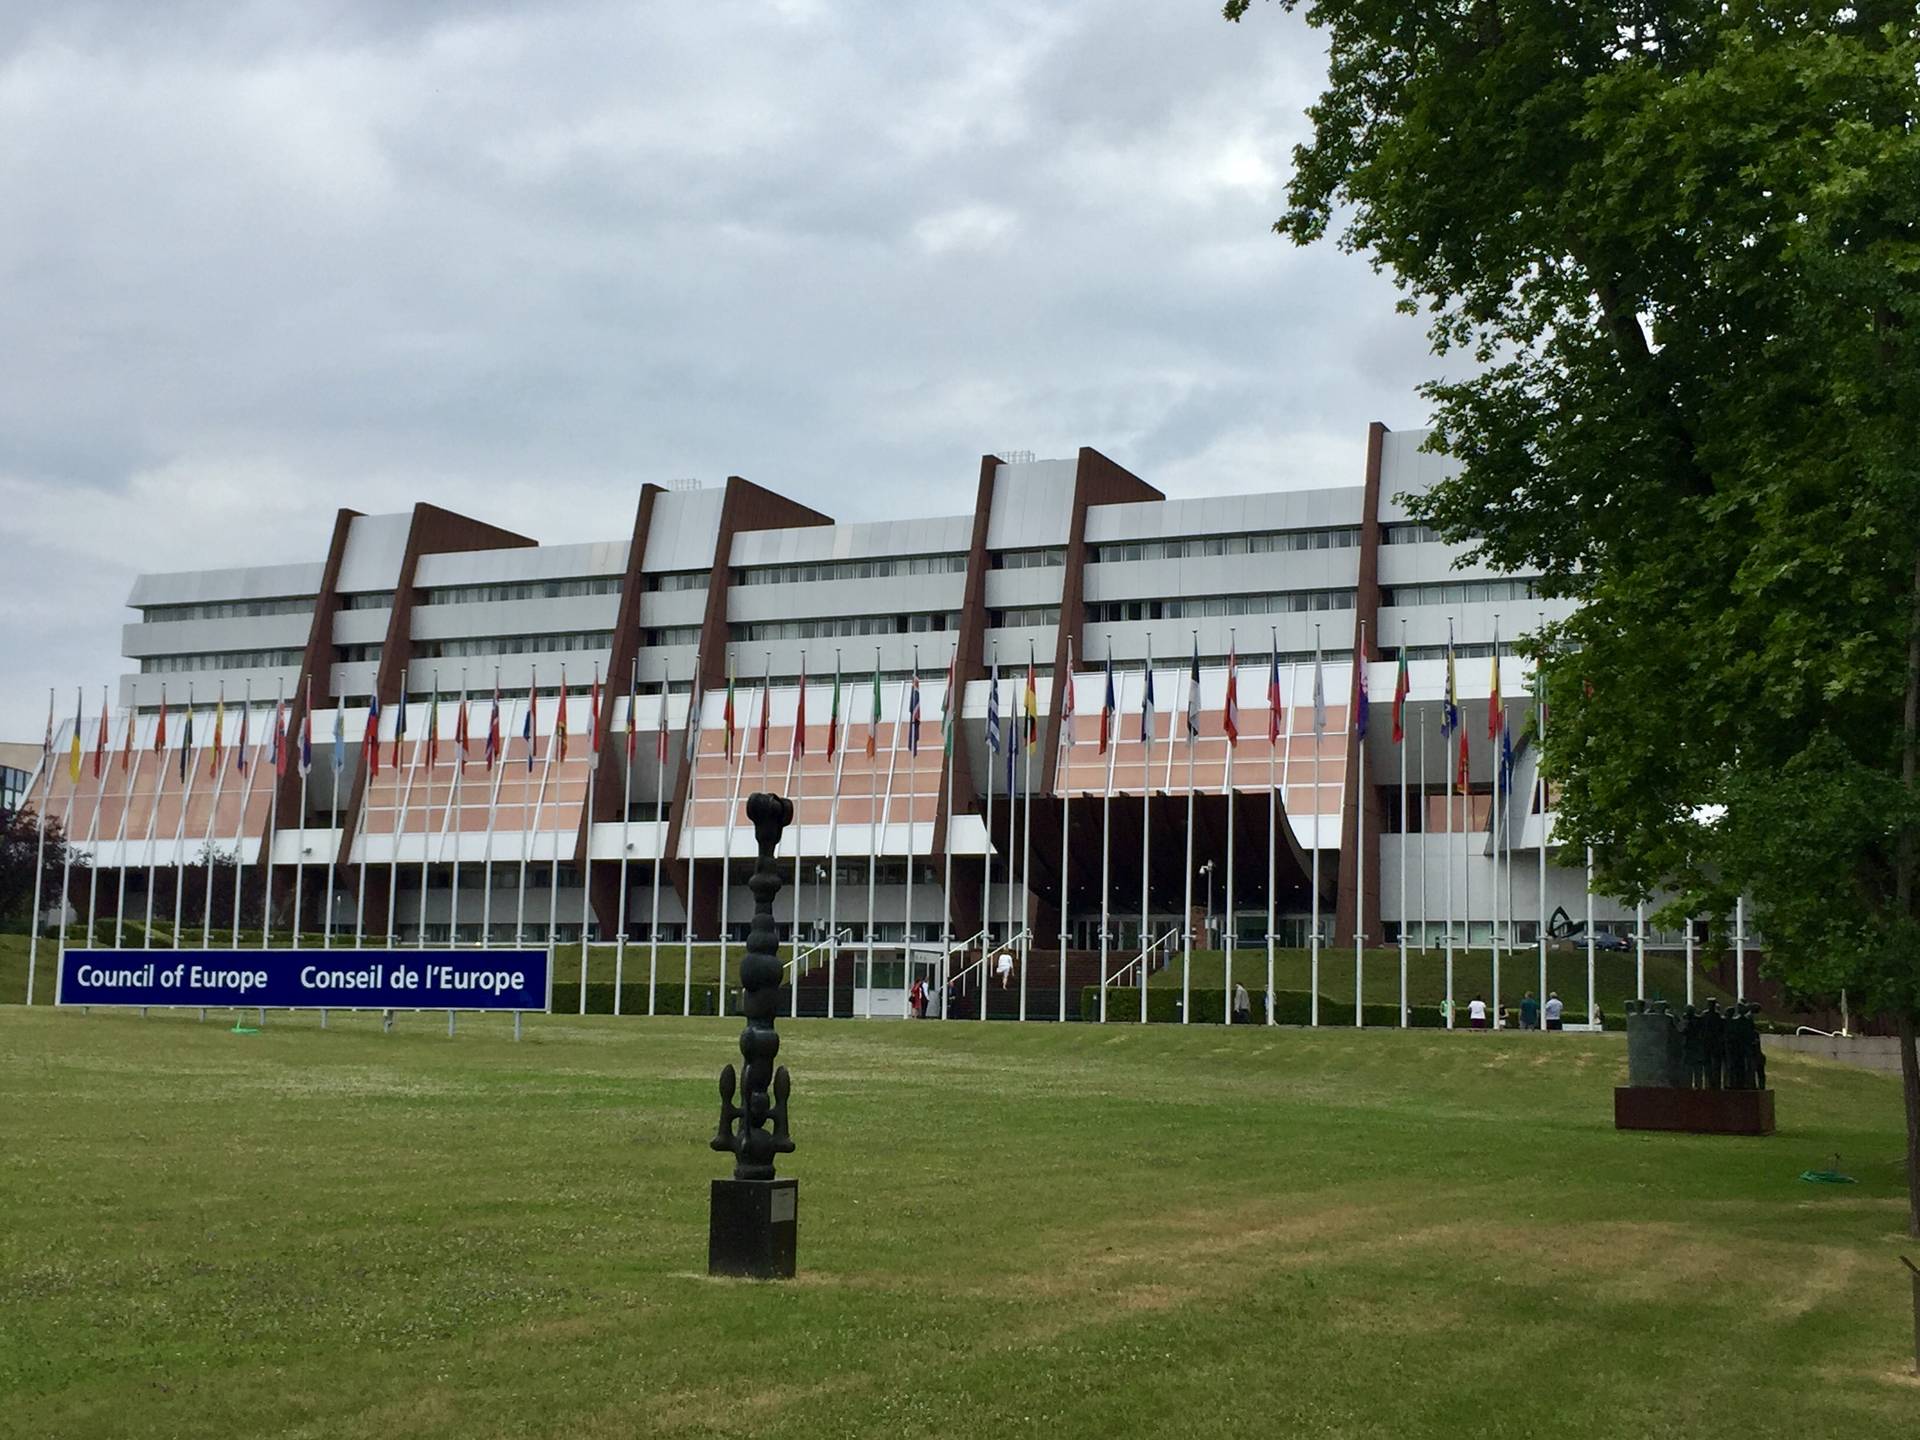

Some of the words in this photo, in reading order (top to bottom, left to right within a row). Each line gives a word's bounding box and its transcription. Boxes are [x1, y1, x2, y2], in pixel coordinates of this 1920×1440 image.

[76, 963, 155, 987] Council
[160, 963, 185, 988] of
[190, 965, 268, 994] Europe
[300, 964, 383, 989] Conseil
[390, 964, 419, 989] de
[425, 964, 525, 996] l'Europe
